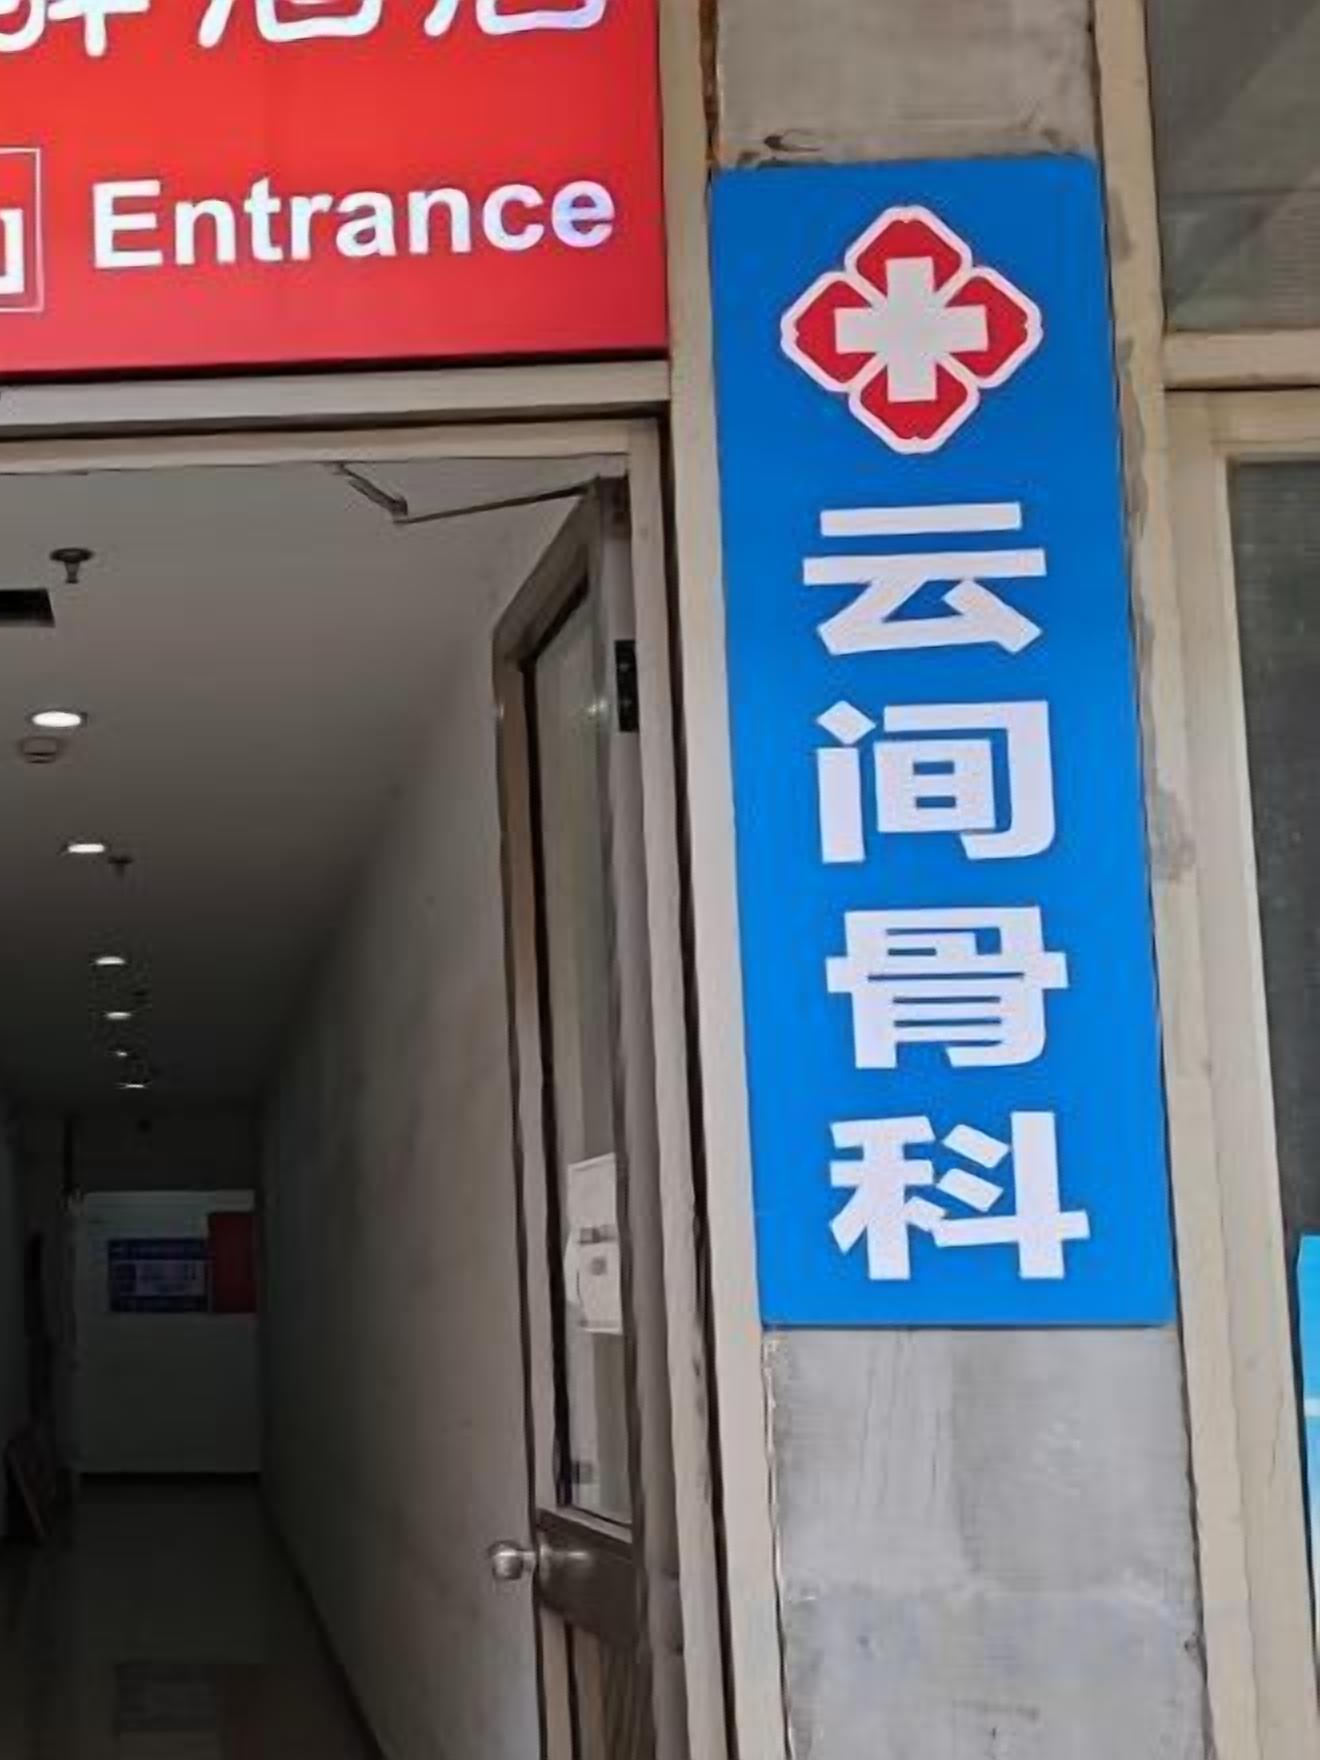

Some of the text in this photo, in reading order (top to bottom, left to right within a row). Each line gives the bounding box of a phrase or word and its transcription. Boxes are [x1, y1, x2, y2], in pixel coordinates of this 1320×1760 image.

[92, 178, 615, 270] Entrance
[802, 502, 1092, 1280] 云间骨科
